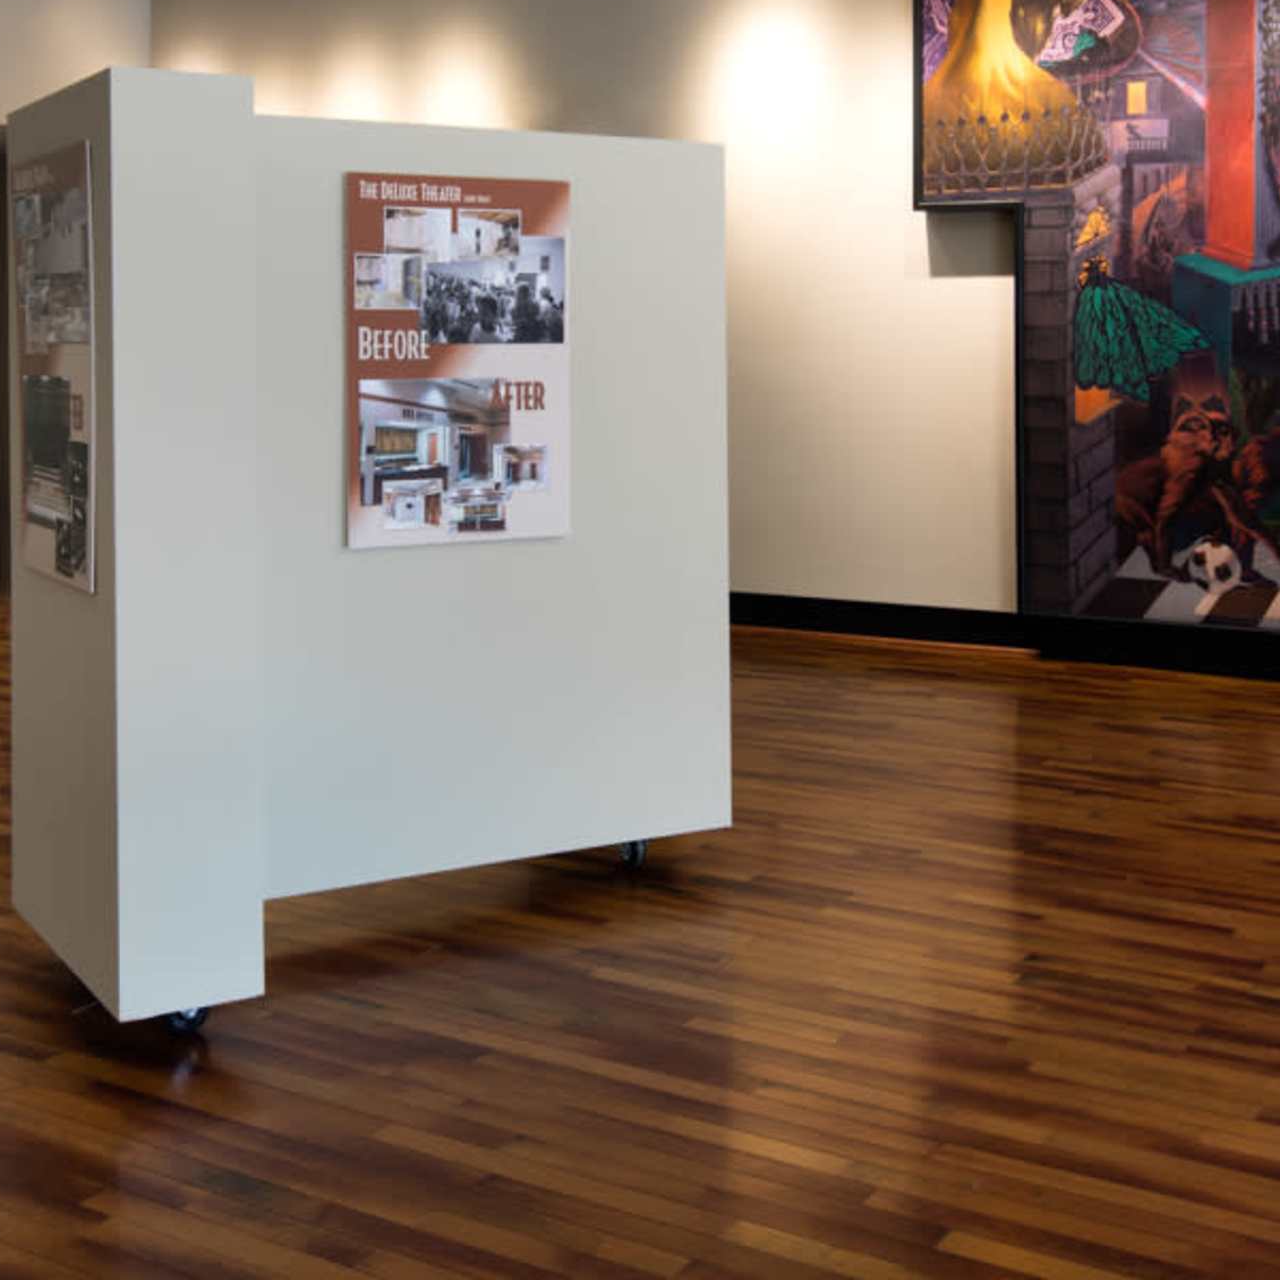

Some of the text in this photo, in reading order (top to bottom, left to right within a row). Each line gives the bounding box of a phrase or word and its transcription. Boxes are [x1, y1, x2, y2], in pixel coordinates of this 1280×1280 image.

[360, 180, 379, 199] THE
[381, 181, 418, 201] DELUXE
[421, 183, 462, 202] THEATER
[358, 326, 431, 361] BEFORE
[490, 377, 545, 410] AFTER
